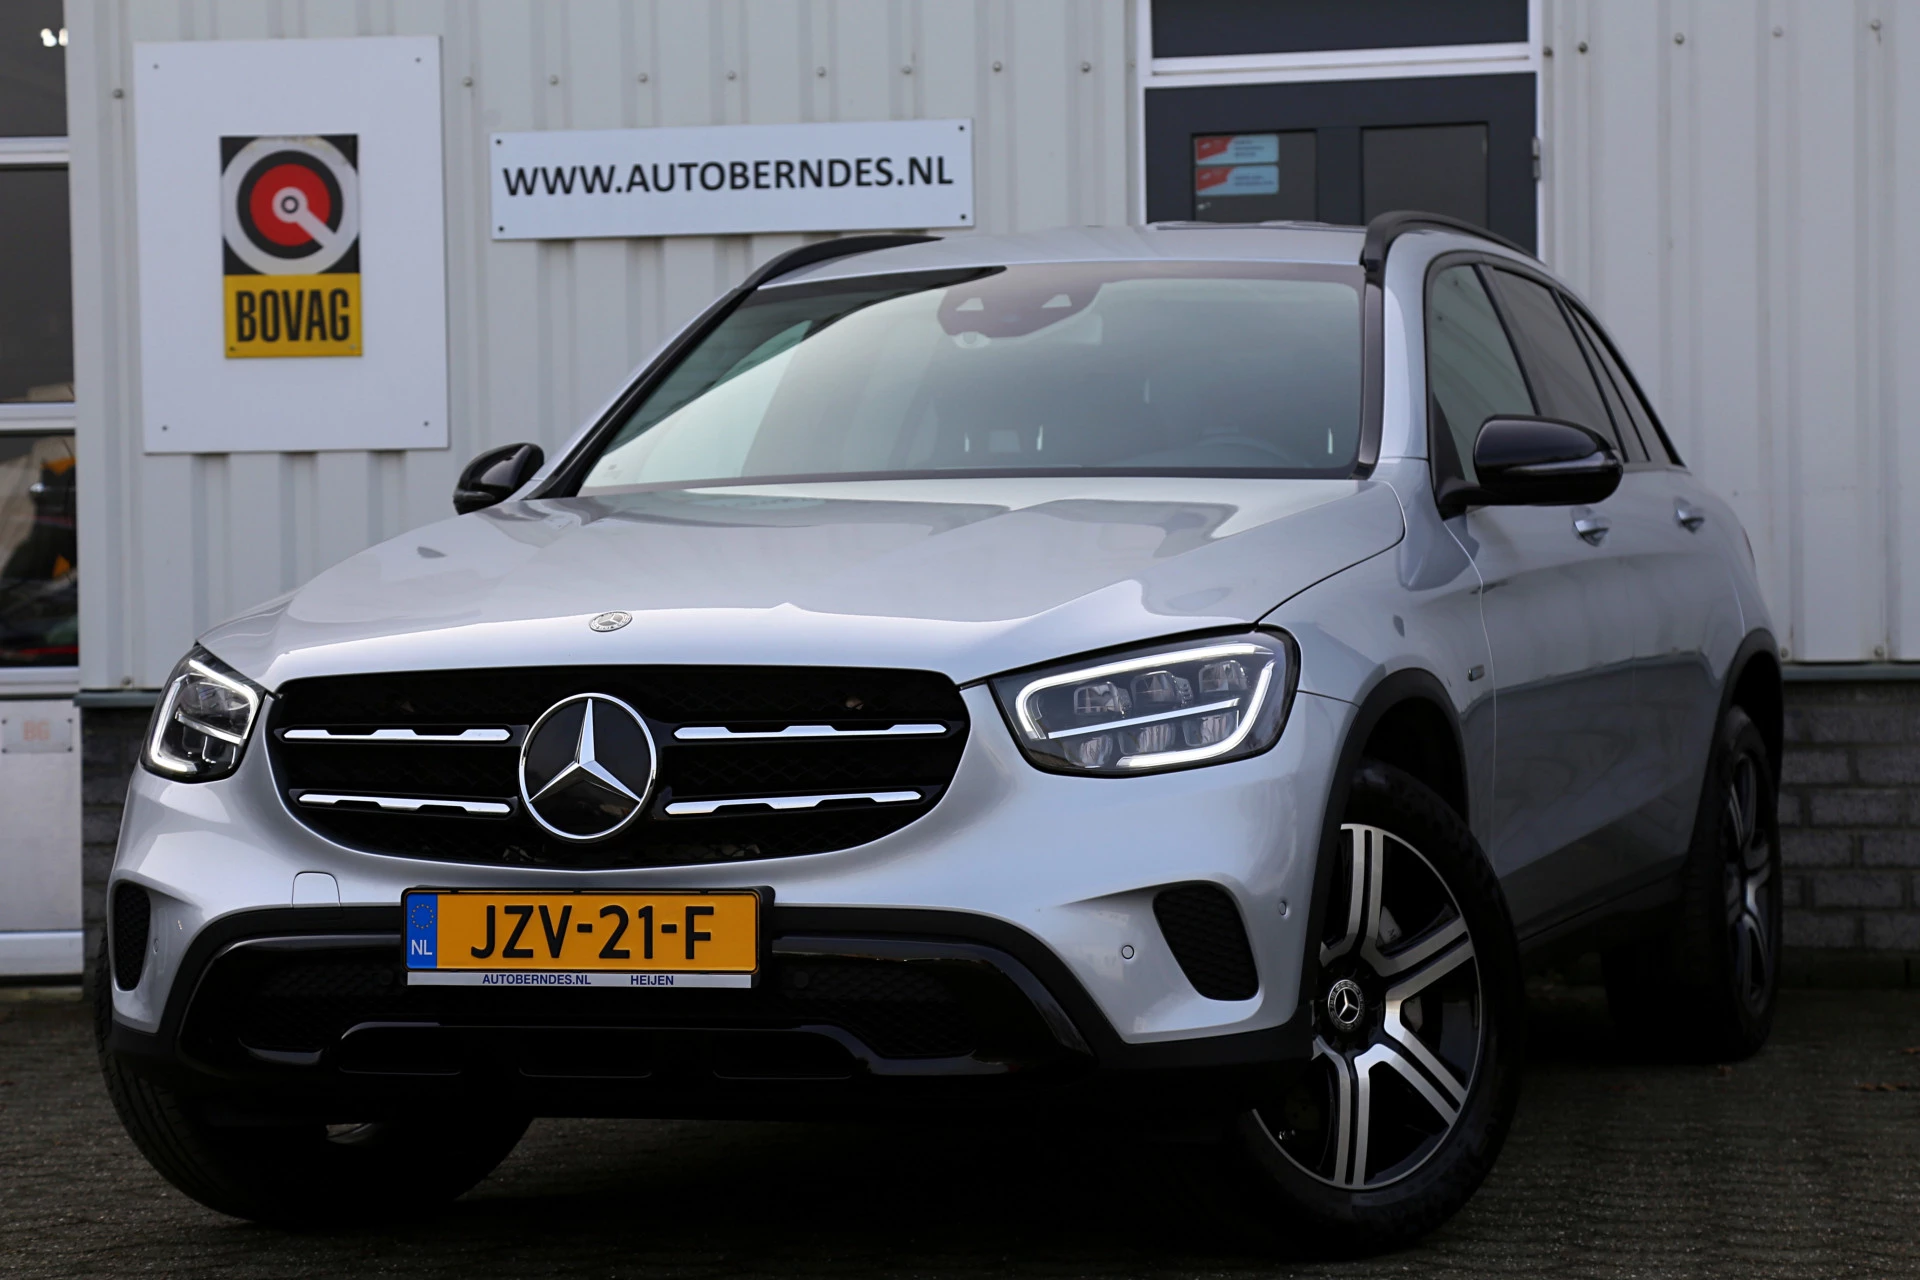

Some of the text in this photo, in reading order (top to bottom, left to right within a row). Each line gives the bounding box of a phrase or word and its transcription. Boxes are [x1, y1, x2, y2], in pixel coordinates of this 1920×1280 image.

[502, 156, 953, 196] WWW.AUTOBERNDES.NL
[235, 288, 350, 342] BOVAG
[411, 940, 432, 955] NL
[471, 905, 714, 959] JZV-21-F
[482, 974, 674, 985] AUTOBERNDES.NL HEIJEN
